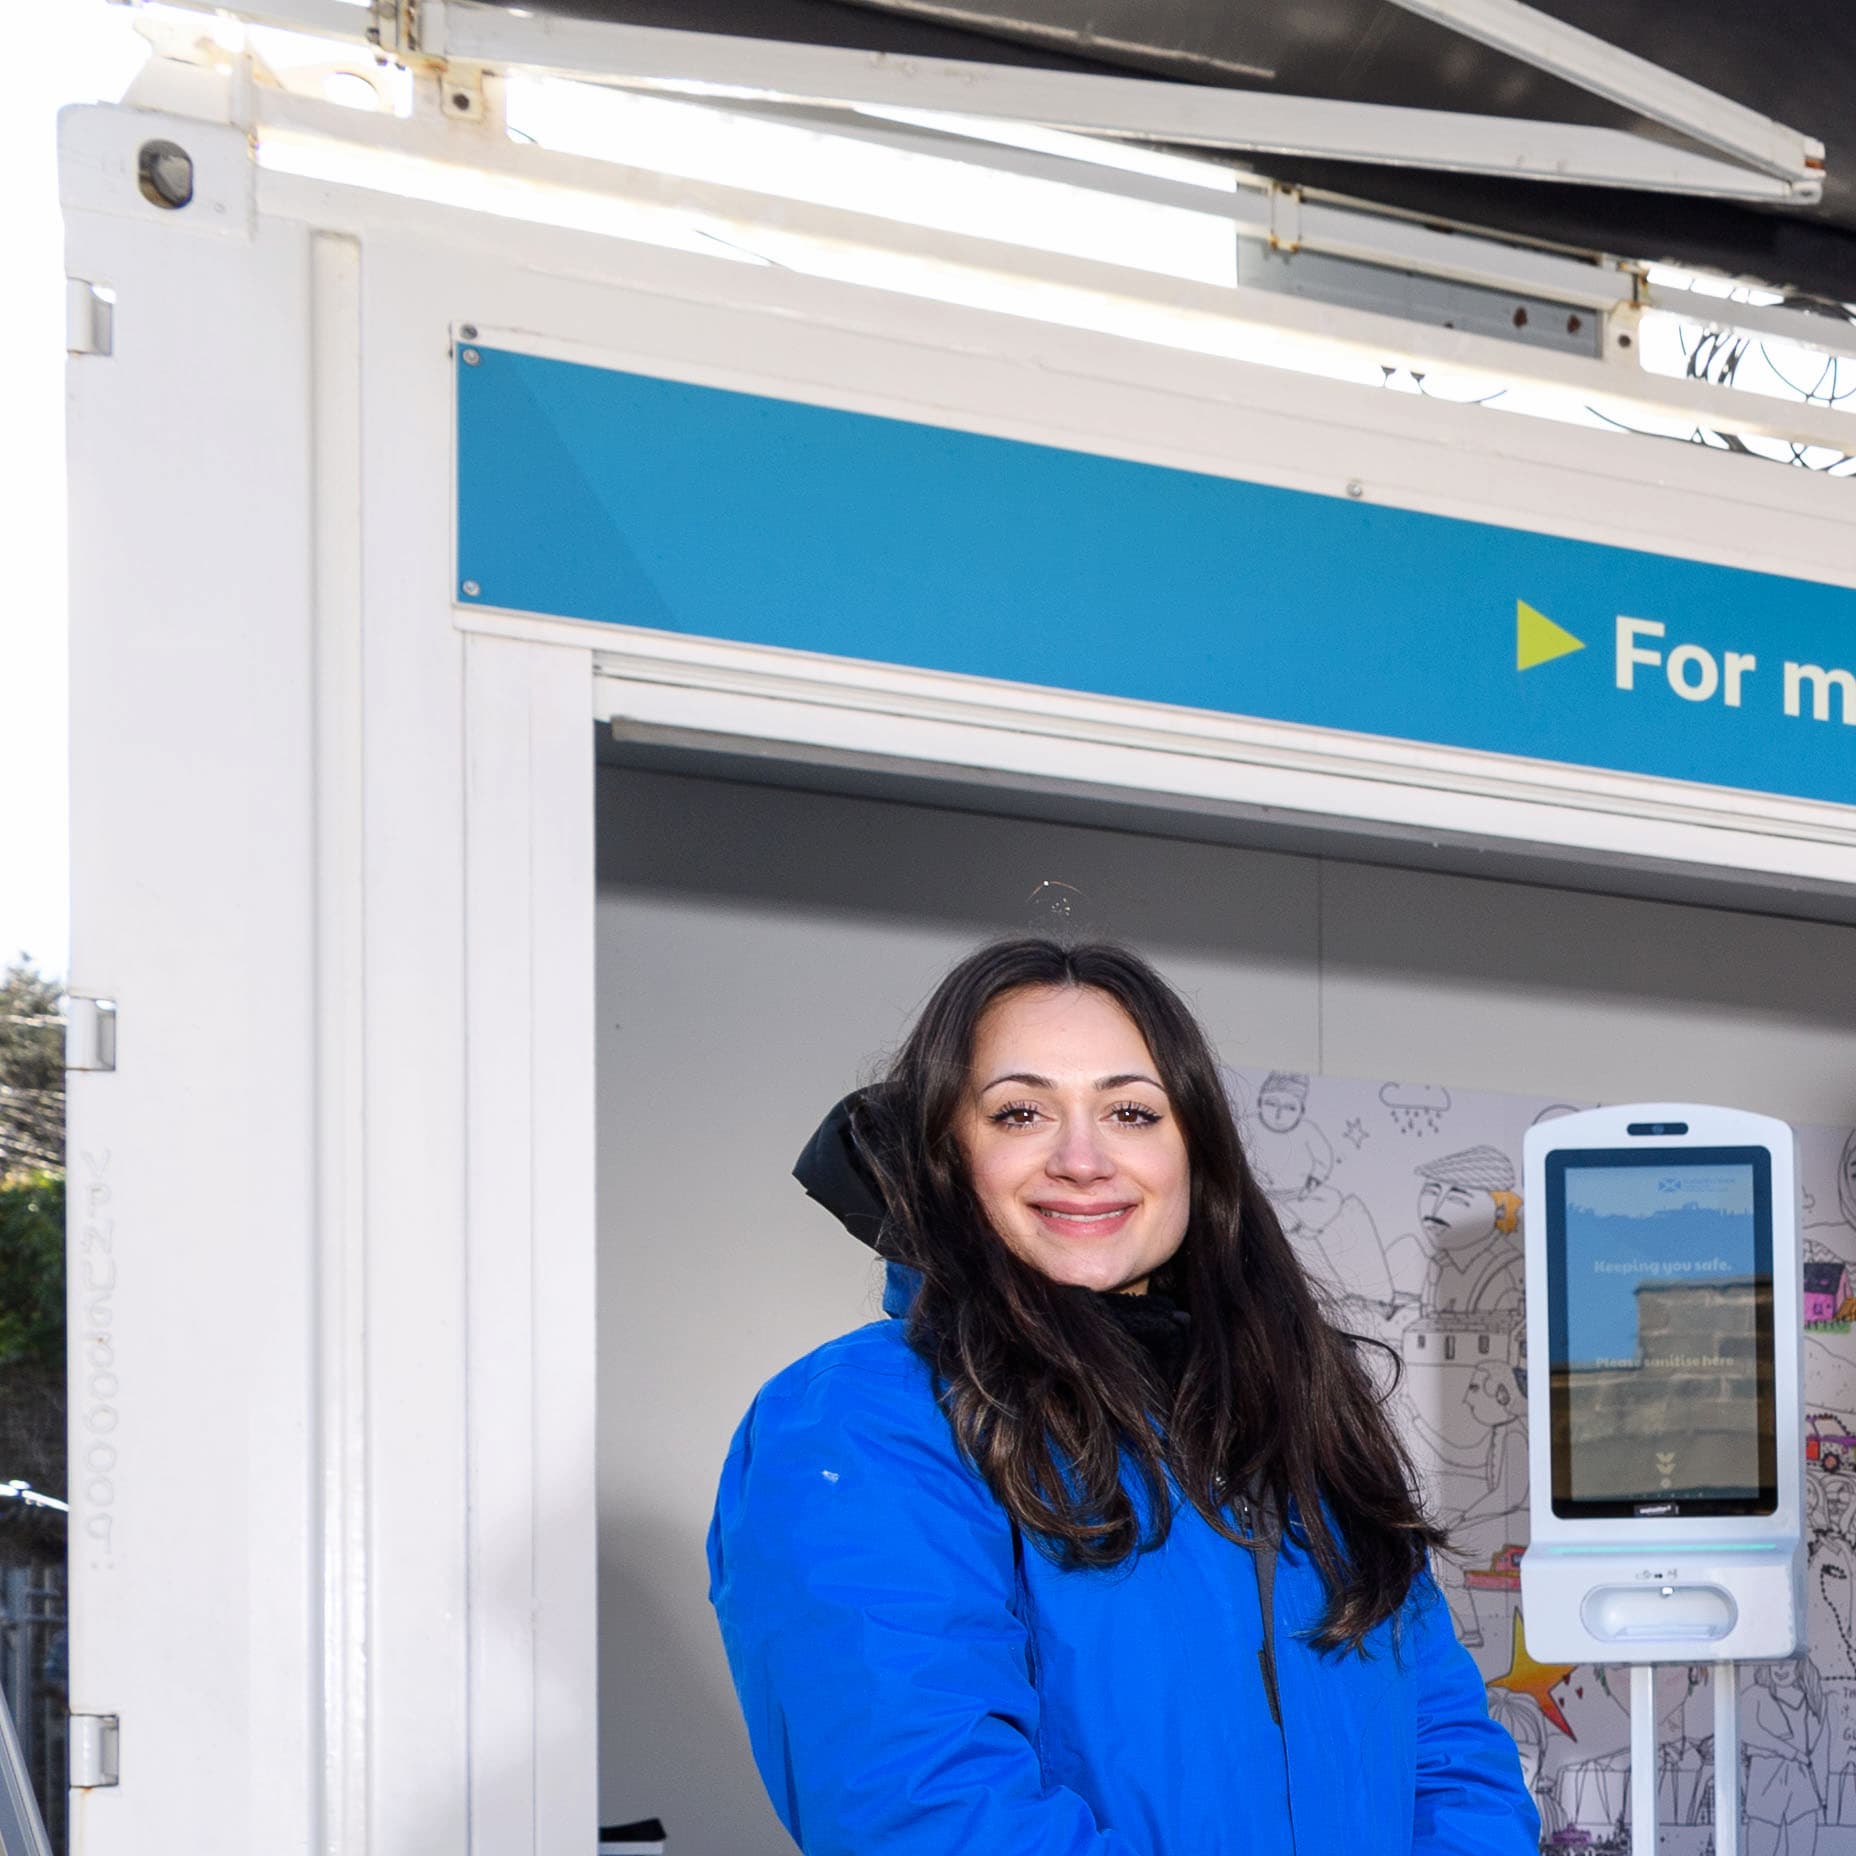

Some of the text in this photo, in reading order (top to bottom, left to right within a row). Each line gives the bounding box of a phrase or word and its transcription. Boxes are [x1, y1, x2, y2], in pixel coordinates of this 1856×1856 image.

[1612, 616, 1757, 708] For
[1595, 1258, 1731, 1275] Keeping you safe.
